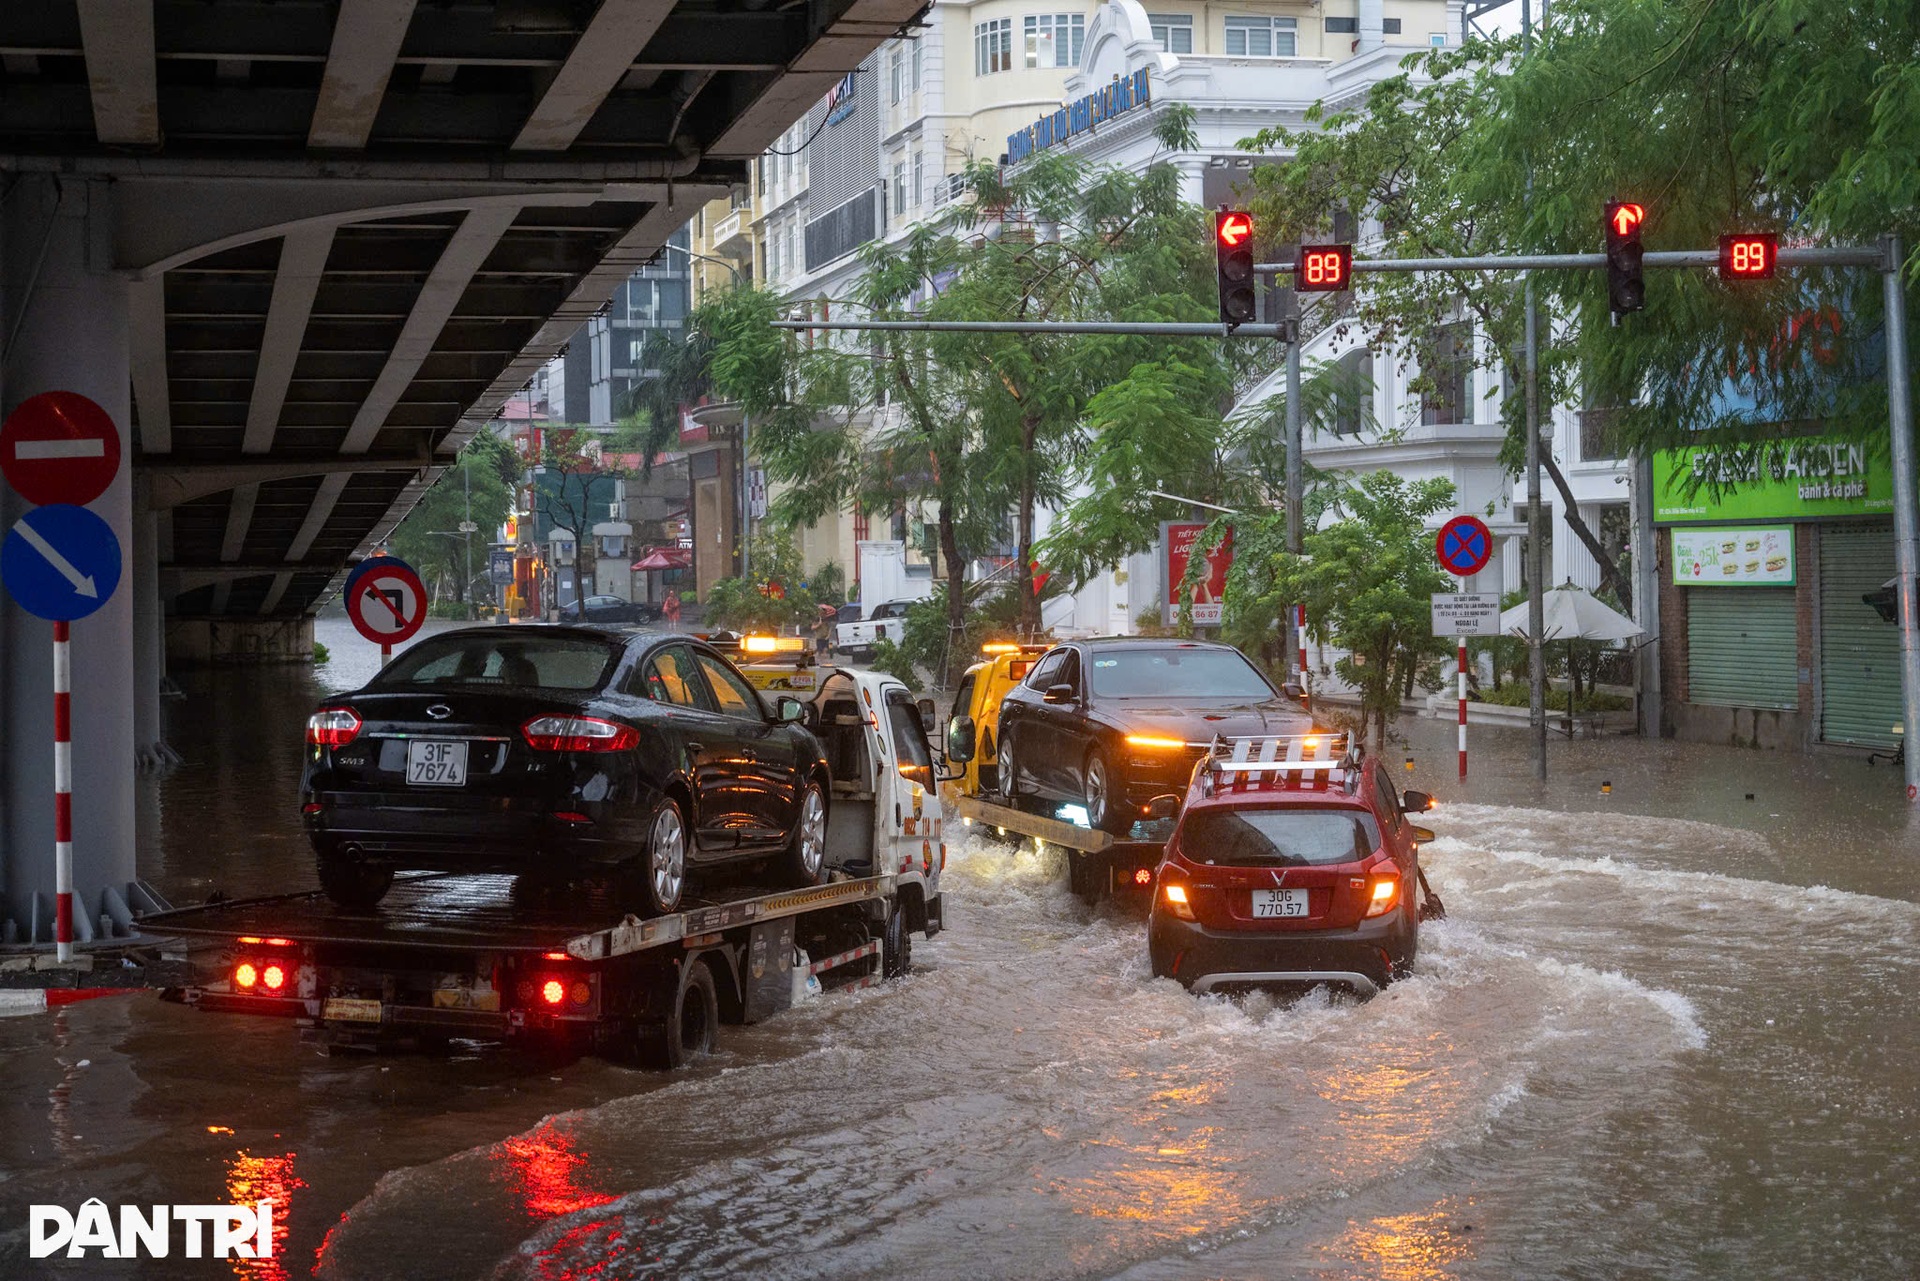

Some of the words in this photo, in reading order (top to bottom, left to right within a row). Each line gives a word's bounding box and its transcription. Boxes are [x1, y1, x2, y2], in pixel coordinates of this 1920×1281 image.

[1732, 242, 1765, 272] 89
[1306, 253, 1341, 283] 89
[340, 757, 365, 765] SM3
[424, 744, 452, 762] 31F
[415, 763, 457, 782] 7674
[1268, 890, 1292, 902] 30G
[1259, 903, 1302, 916] 770.57
